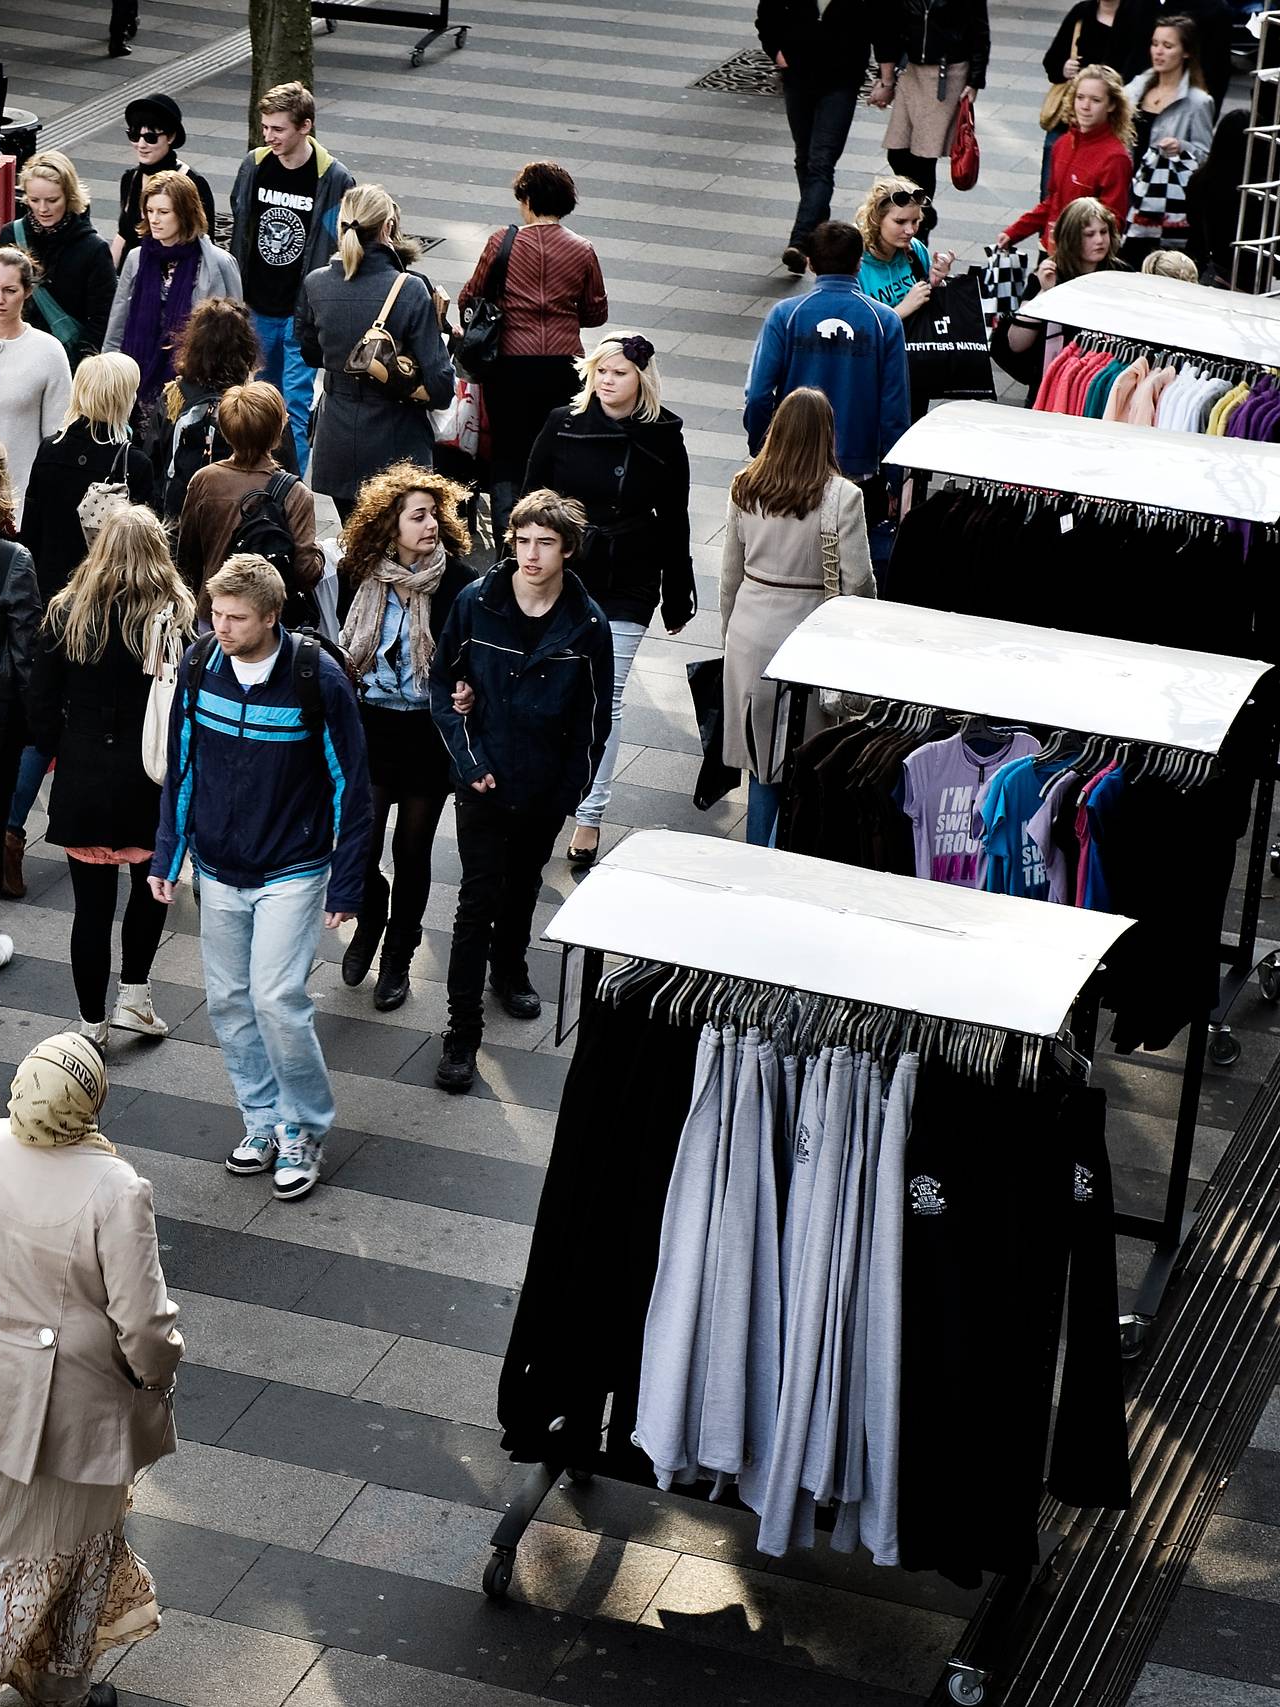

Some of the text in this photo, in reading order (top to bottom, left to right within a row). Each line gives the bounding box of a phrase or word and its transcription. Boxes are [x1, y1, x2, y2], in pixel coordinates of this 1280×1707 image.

[258, 187, 314, 212] RAMONES
[905, 341, 987, 352] UTFITTERS NATION
[939, 786, 973, 814] I'M
[936, 813, 971, 834] SWE
[934, 832, 978, 855] TROU
[1022, 845, 1046, 866] SW
[933, 855, 977, 881] MAK
[1022, 865, 1049, 888] TR
[59, 1051, 97, 1101] CHANEL
